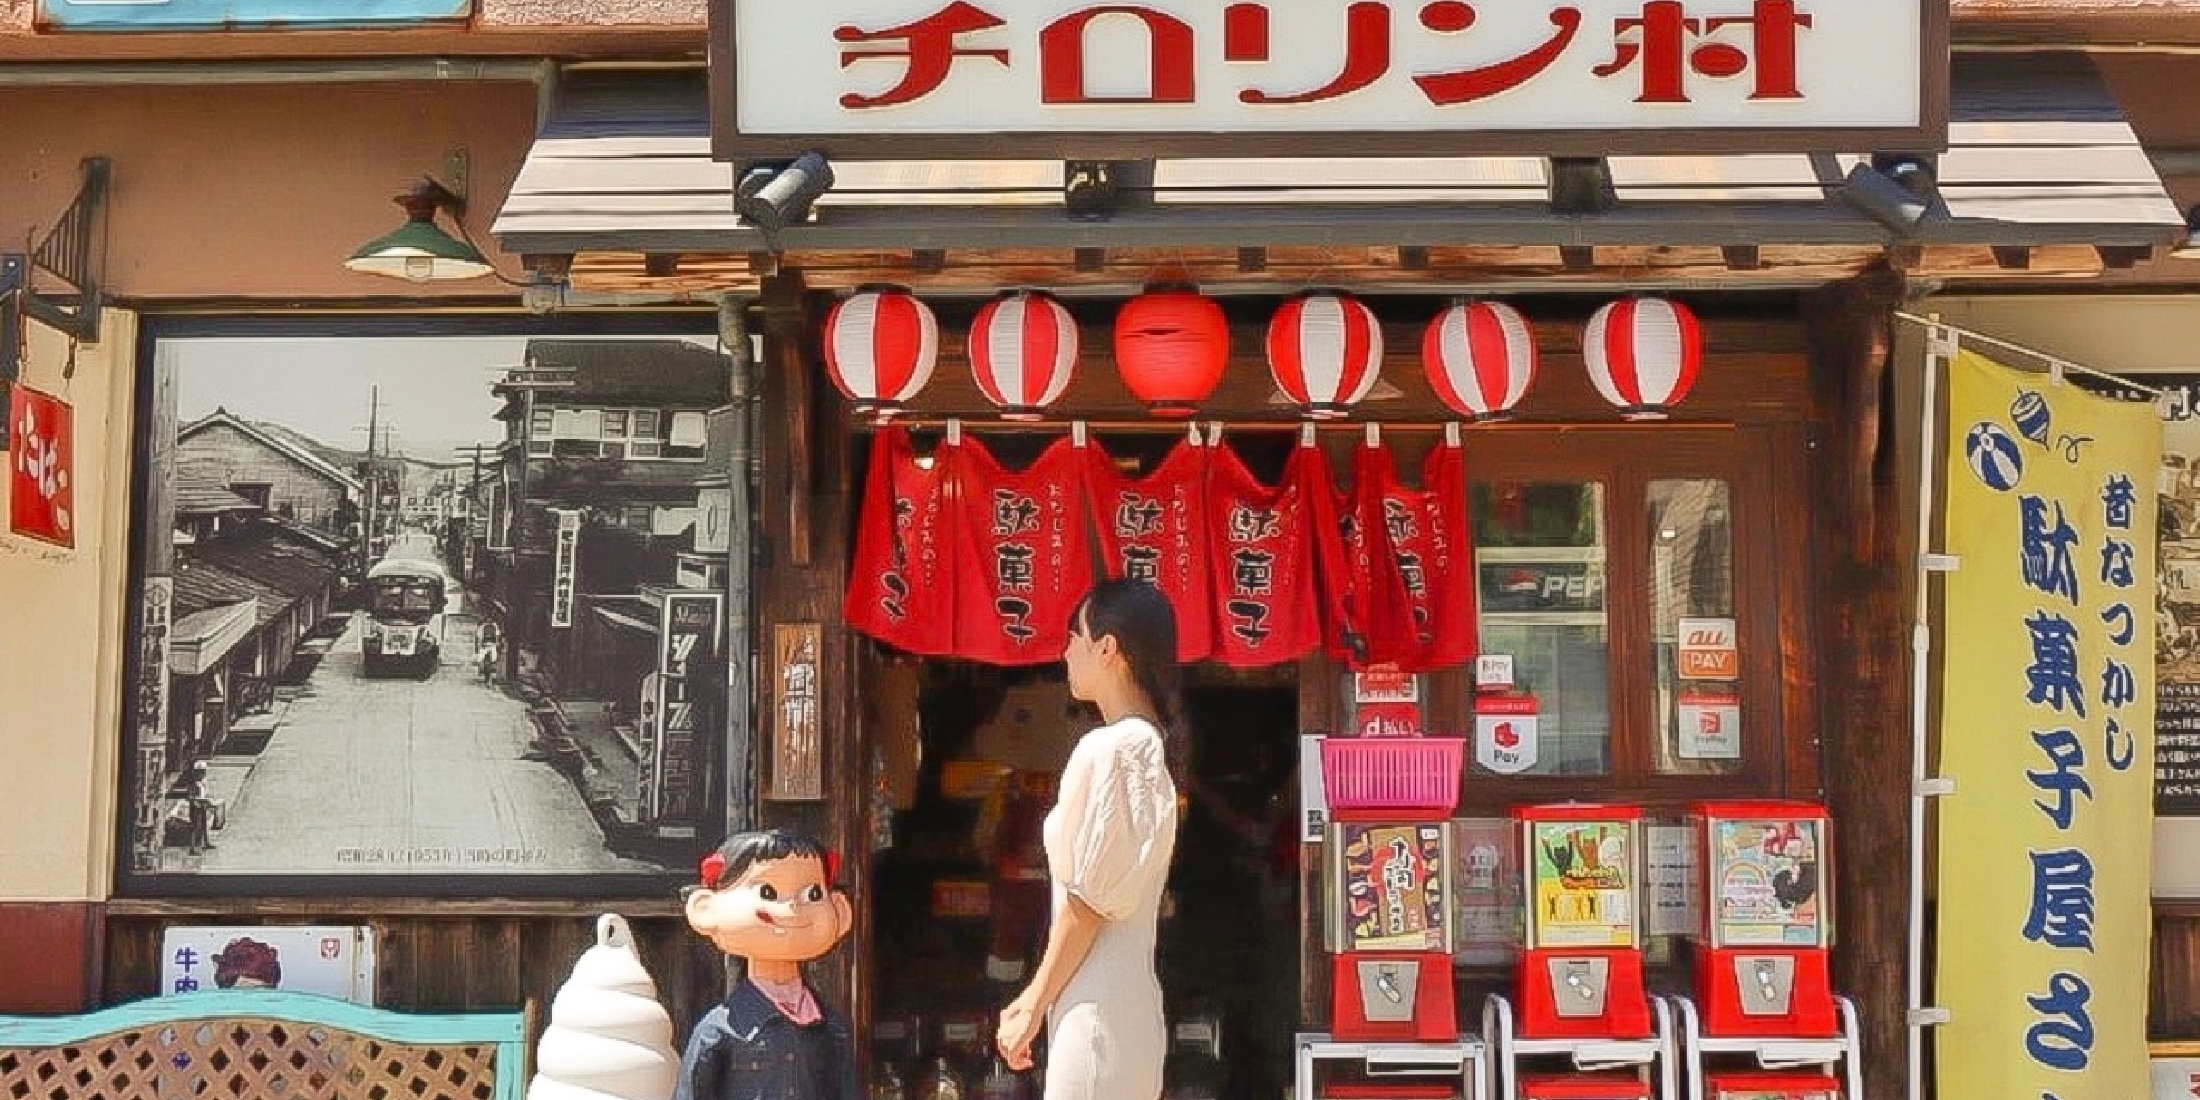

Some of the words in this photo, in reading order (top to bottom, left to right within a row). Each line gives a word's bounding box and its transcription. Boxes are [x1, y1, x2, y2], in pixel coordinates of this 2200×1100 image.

[834, 0, 1812, 108] チロリン村
[18, 401, 71, 532] たばこ
[991, 488, 1040, 645] 駄菓子
[1226, 499, 1282, 648] 駄菓子
[2100, 474, 2137, 771] 昔なつかし
[1687, 630, 1728, 646] au
[1691, 652, 1728, 668] PAY
[1493, 749, 1519, 764] Pay
[2018, 495, 2096, 1100] 駄菓子屋さ
